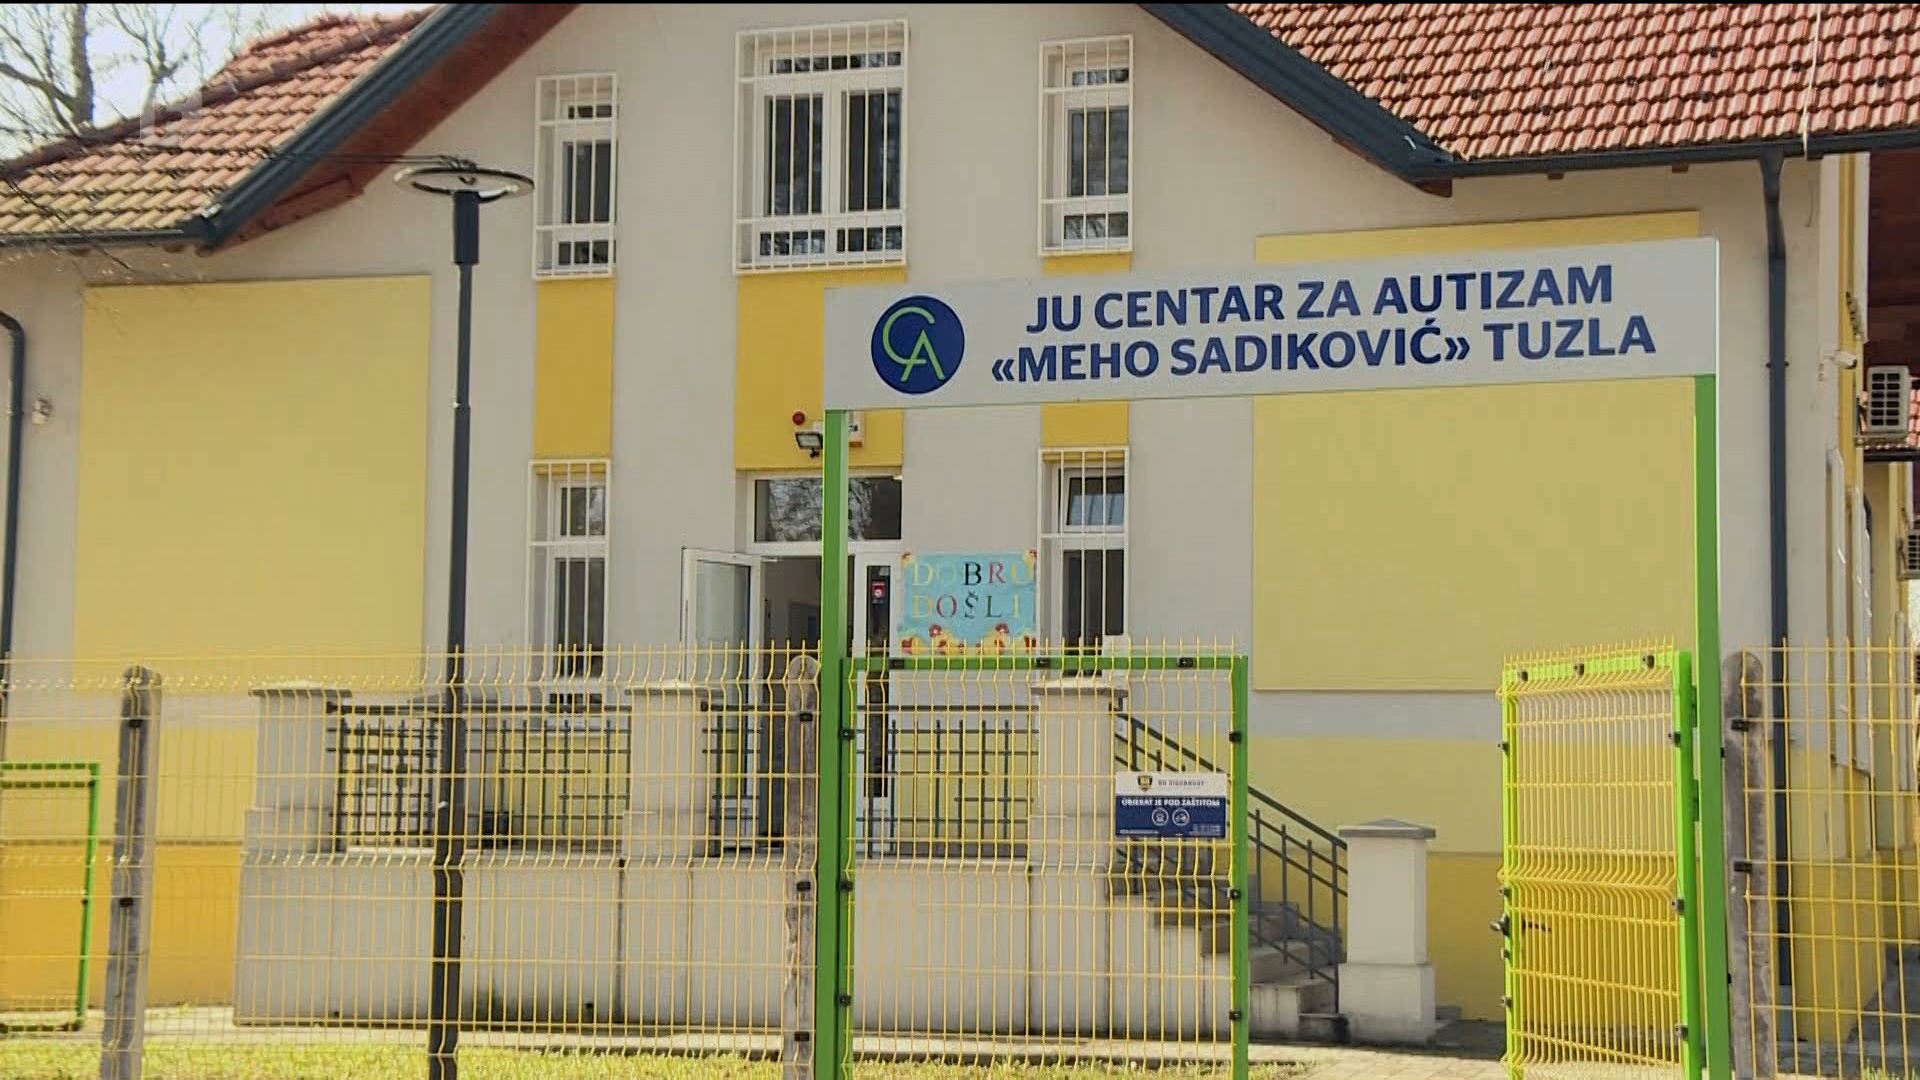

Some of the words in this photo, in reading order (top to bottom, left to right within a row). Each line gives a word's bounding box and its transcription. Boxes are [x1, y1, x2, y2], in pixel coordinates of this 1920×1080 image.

[1026, 294, 1082, 334] JU
[1094, 285, 1285, 330] CENTAR
[1296, 281, 1361, 320] ZA
[1372, 264, 1612, 316] AUTIZAM
[991, 343, 1160, 383] «MEHO
[1170, 317, 1471, 377] SADIKOVIĆ»
[1482, 315, 1657, 364] TUZLA
[912, 561, 1034, 588] DOBRO
[912, 589, 1020, 621] DOŠLI
